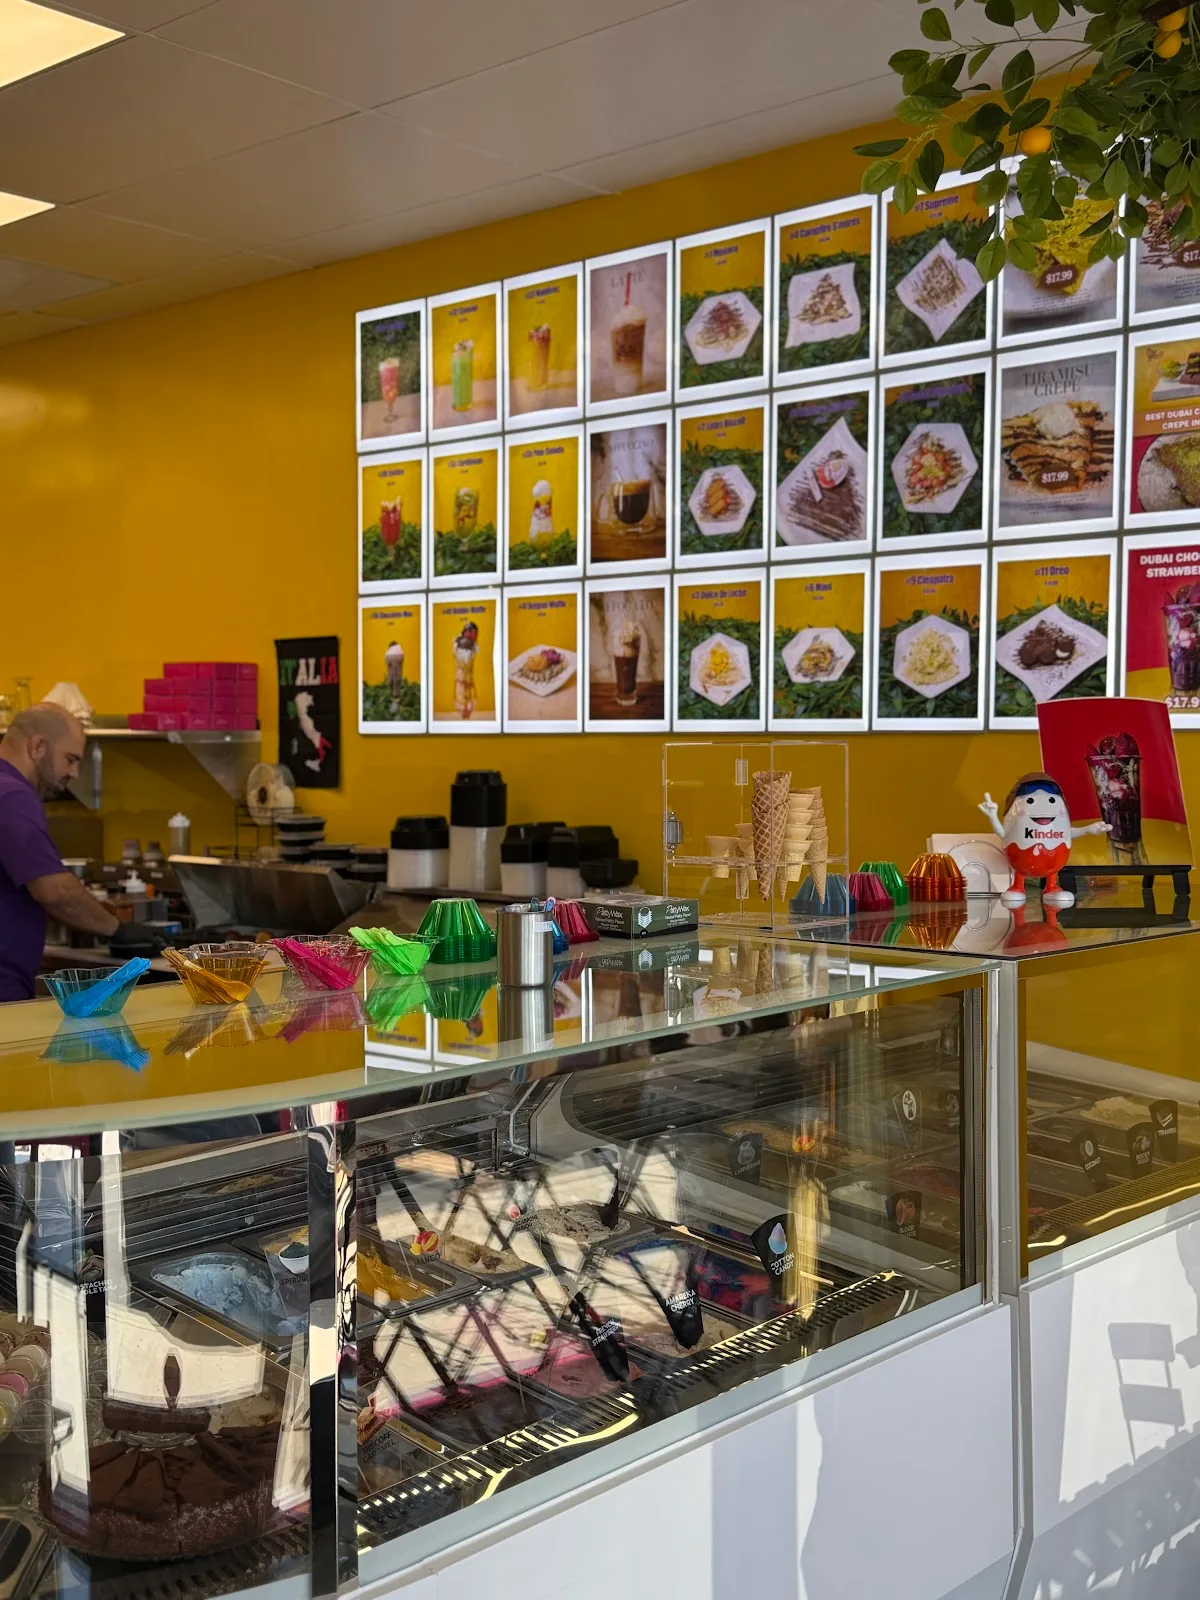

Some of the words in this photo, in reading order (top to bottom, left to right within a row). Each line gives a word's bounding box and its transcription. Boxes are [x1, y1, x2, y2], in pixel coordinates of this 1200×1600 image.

[924, 195, 959, 210] Supreme
[1045, 271, 1073, 285] $17.99
[1021, 363, 1093, 387] TIRAMISU
[1033, 379, 1081, 397] CREPE
[1145, 412, 1166, 422] BEST
[1167, 409, 1193, 419] DUBAI
[1162, 420, 1190, 430] CREPE
[1041, 471, 1069, 484] $17.99
[1140, 554, 1173, 566] DUBAI
[1175, 551, 1200, 563] CHO
[1034, 567, 1048, 577] #11
[1049, 565, 1070, 576] Oreo
[1146, 565, 1200, 578] STRAWBE
[917, 574, 954, 585] Cleopatra
[280, 656, 338, 686] ITALIA
[1164, 696, 1200, 709] $17.9
[1157, 1127, 1177, 1136] TIRAMISU
[414, 1251, 441, 1266] MANGO
[770, 1252, 795, 1271] COTTON
[774, 1259, 794, 1276] CANDY
[665, 1289, 696, 1307] AMARENA
[670, 1297, 694, 1312] CHERRY
